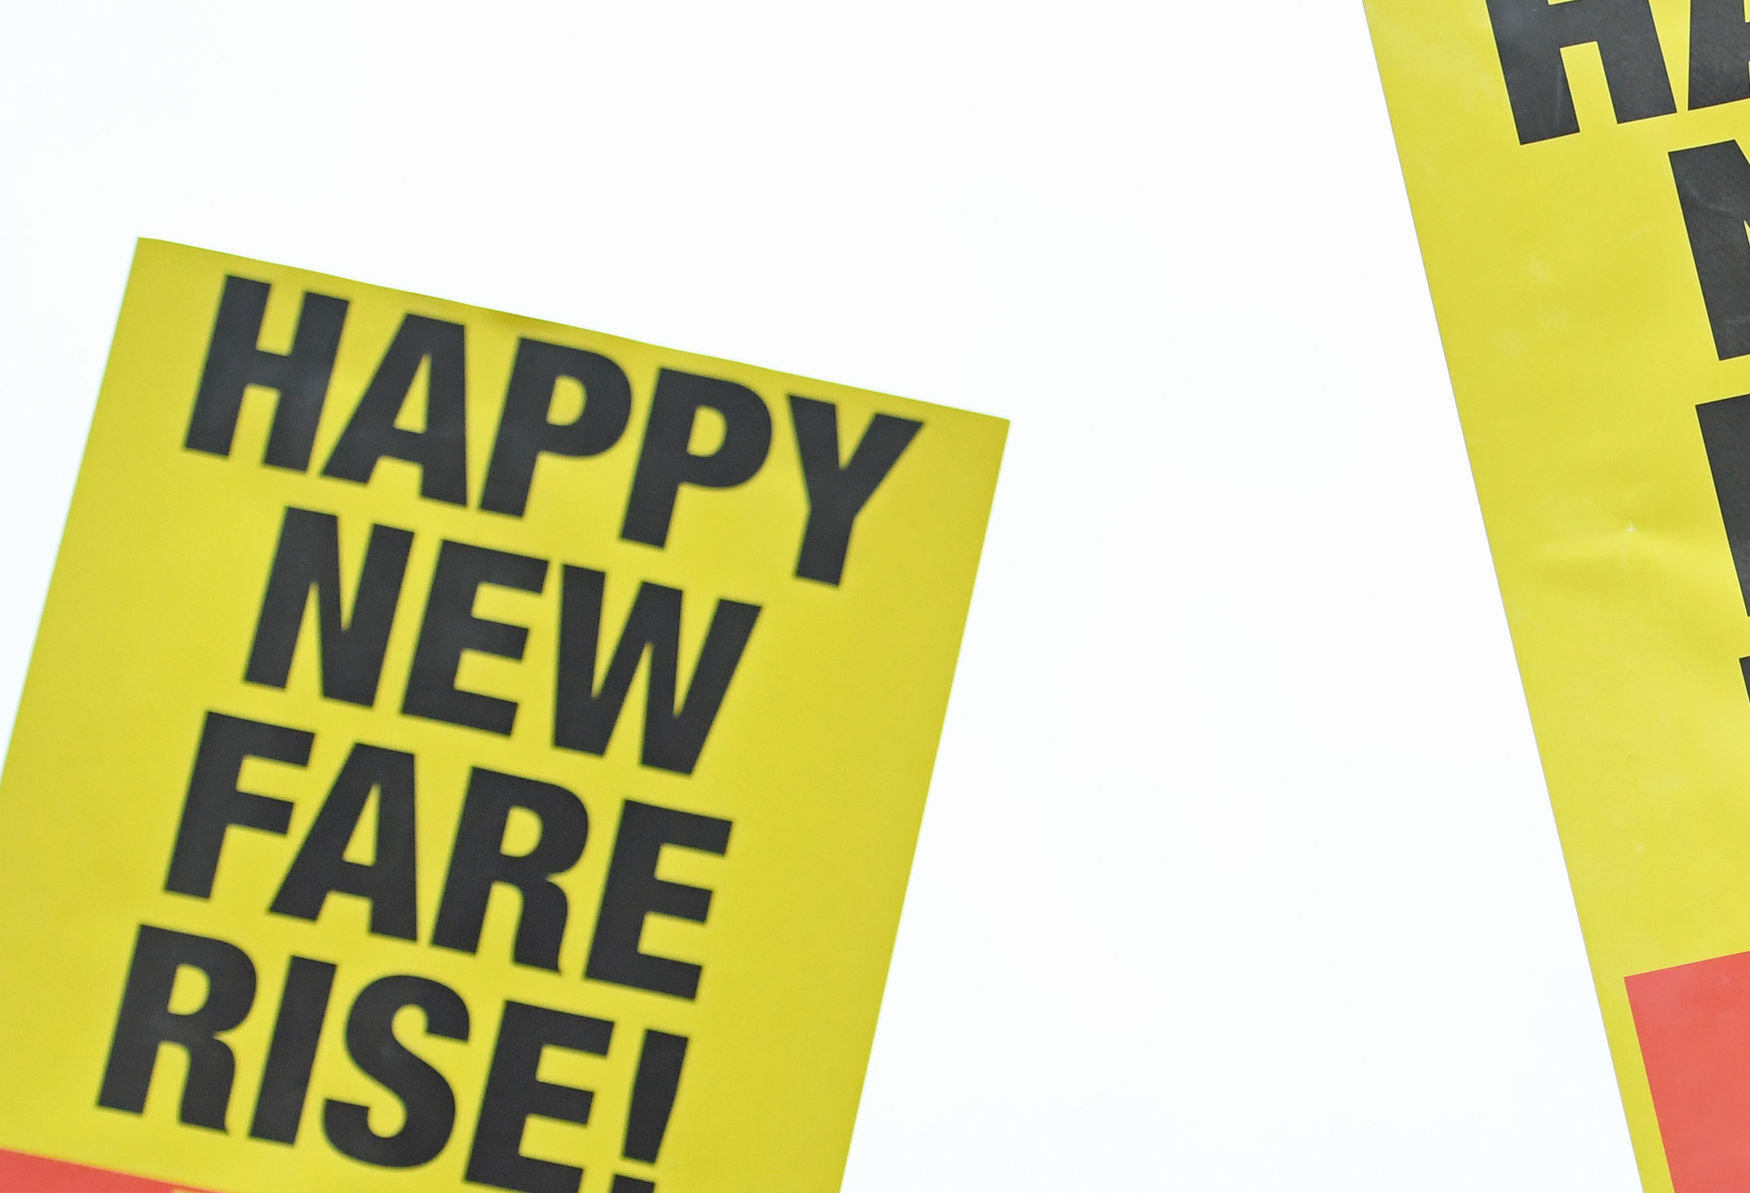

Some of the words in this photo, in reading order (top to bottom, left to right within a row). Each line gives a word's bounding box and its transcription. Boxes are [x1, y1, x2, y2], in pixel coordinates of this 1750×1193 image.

[185, 275, 923, 586] HAPPY
[244, 507, 762, 775] NEW
[165, 711, 732, 1001] FARE
